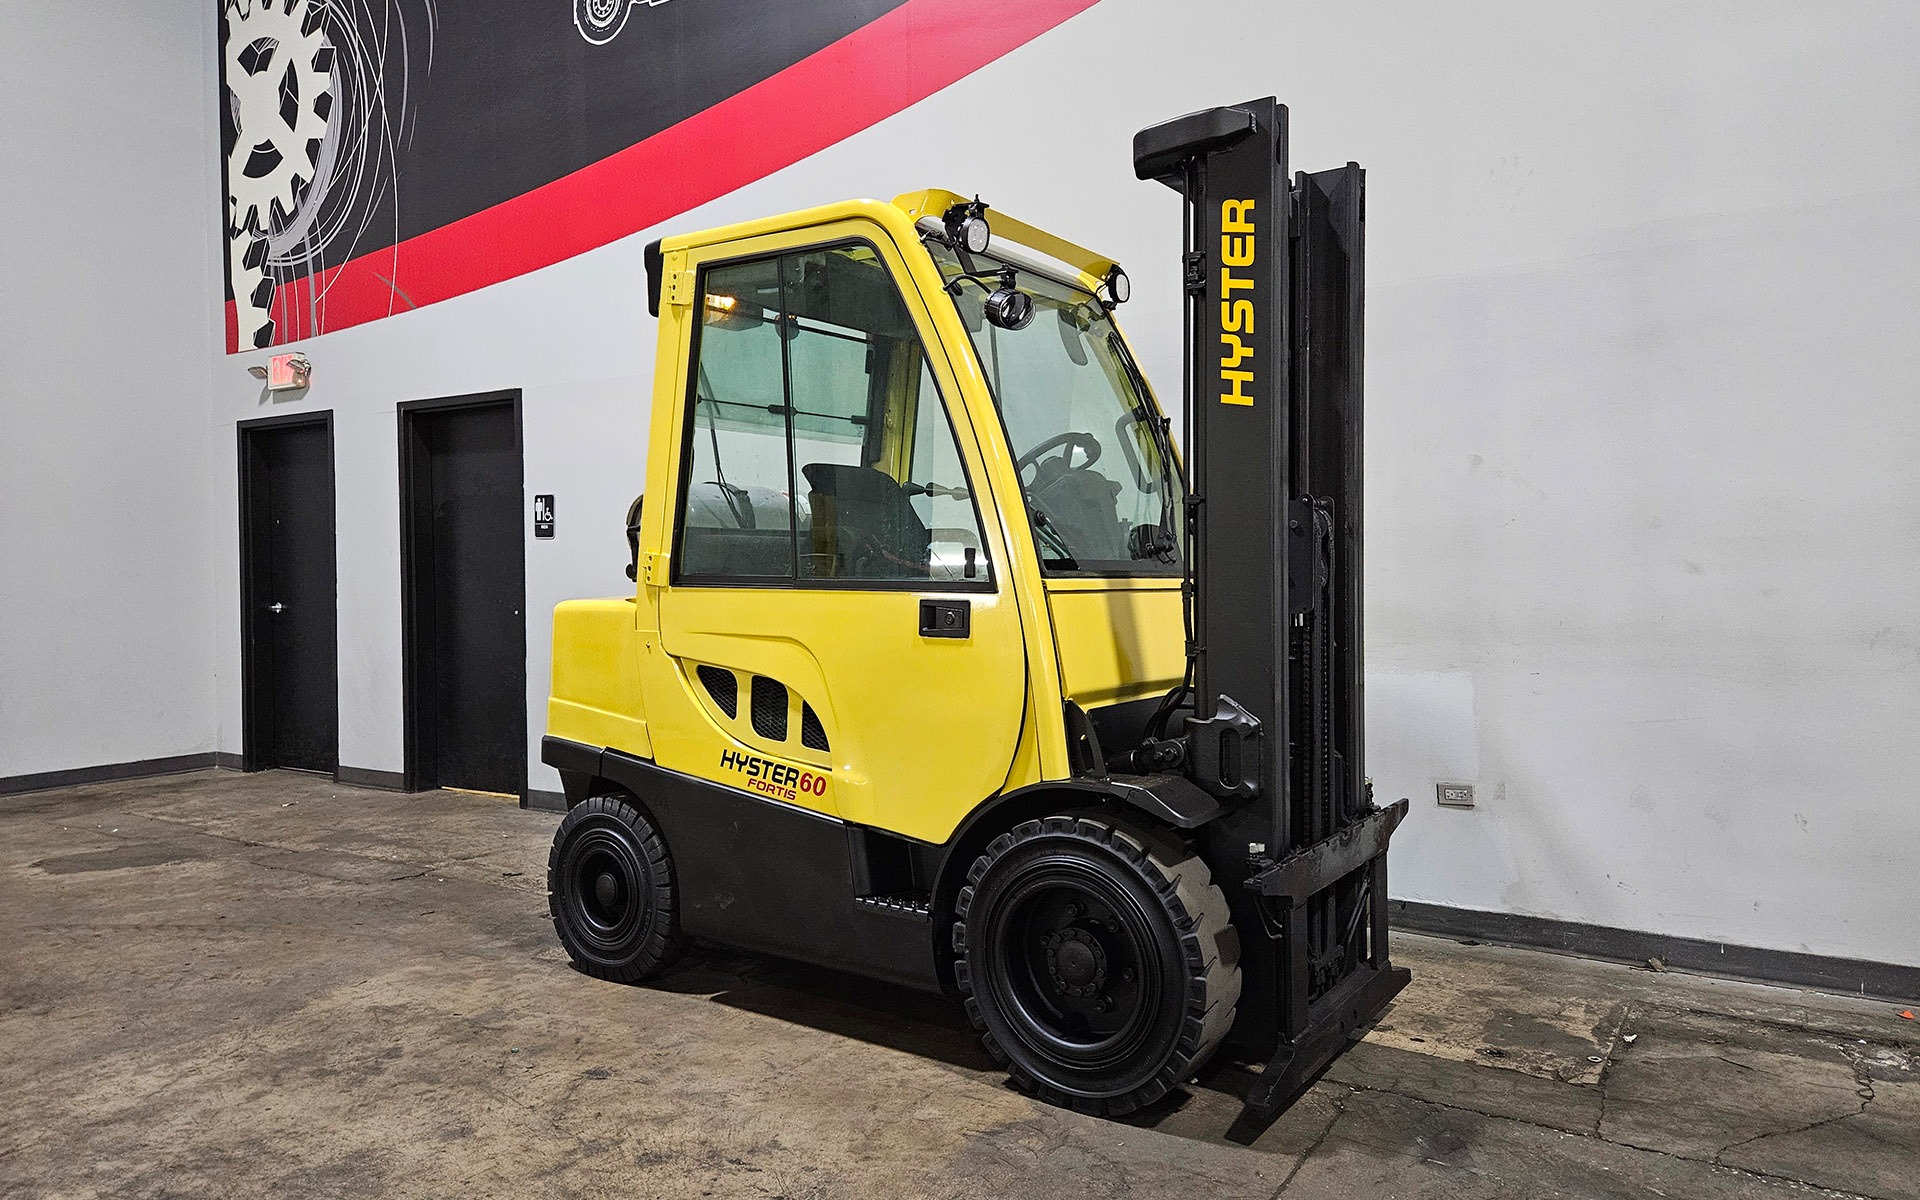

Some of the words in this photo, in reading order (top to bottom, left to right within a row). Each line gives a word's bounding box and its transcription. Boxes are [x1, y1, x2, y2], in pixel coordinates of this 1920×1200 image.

[1220, 199, 1255, 406] HYSTER
[720, 749, 800, 788] HYSTER
[800, 772, 827, 797] 60
[747, 778, 797, 800] FORTIS
